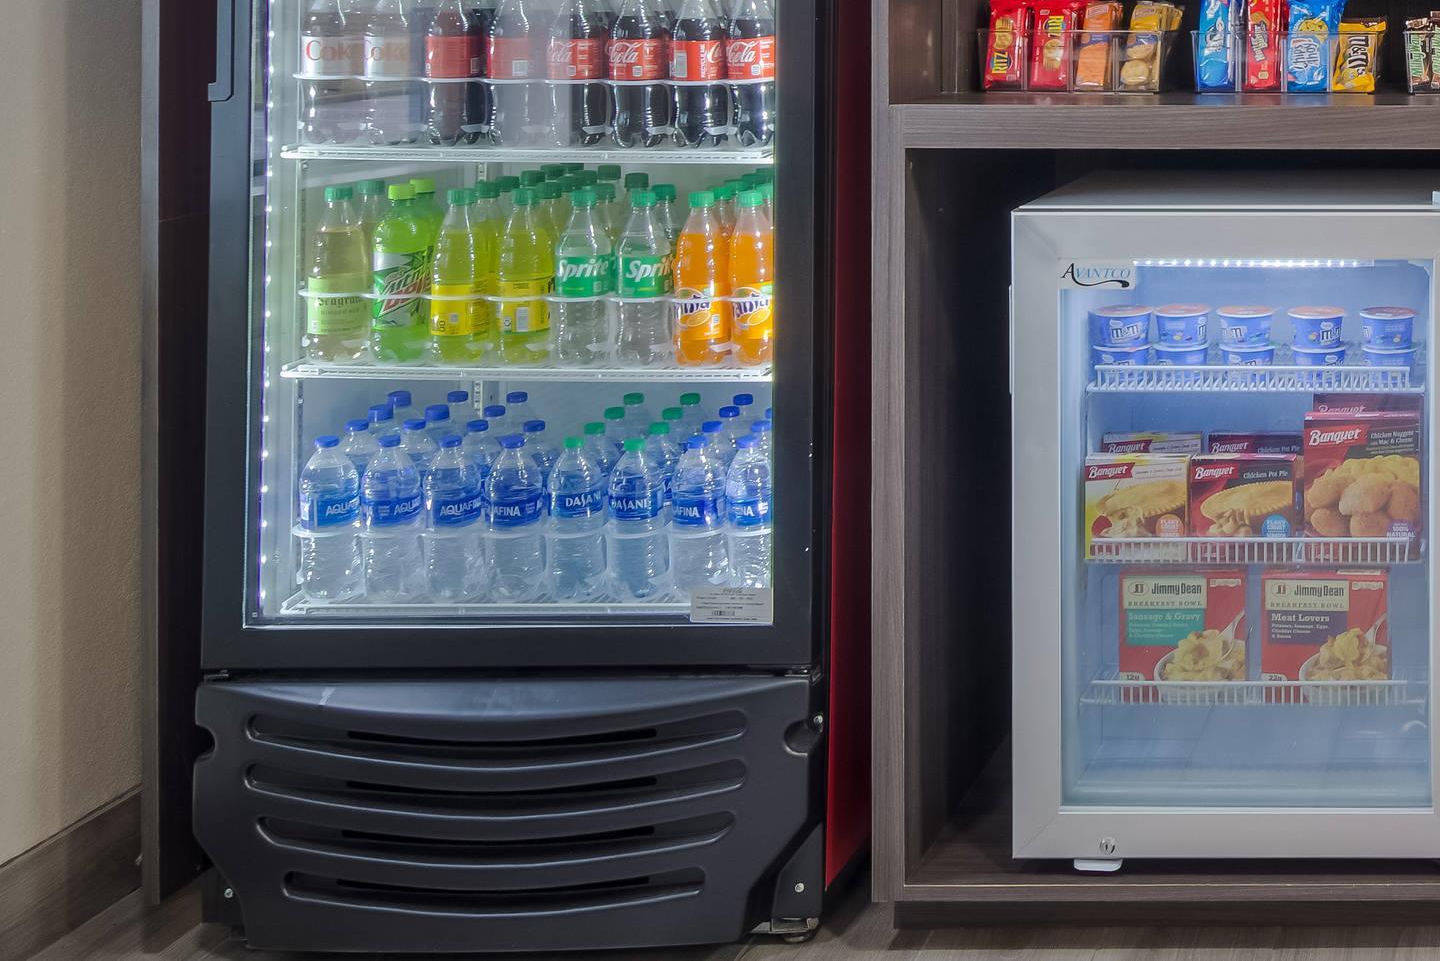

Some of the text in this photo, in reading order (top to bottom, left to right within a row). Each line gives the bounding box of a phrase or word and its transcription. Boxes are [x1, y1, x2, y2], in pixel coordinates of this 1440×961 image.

[1047, 15, 1065, 38] RITZ
[991, 51, 1009, 74] RITZ
[556, 256, 609, 282] Sprite
[1309, 428, 1363, 446] Banquet
[1107, 442, 1146, 453] Banquet
[1211, 441, 1248, 453] Banquet
[1088, 466, 1128, 479] Banquet
[1194, 466, 1235, 480] Banquet
[1243, 471, 1267, 479] Chicken
[1151, 582, 1202, 595] Jimmy Dean
[1294, 584, 1344, 597] Jimmy Dean
[1174, 613, 1201, 622] Gravy
[1271, 613, 1296, 621] Meat
